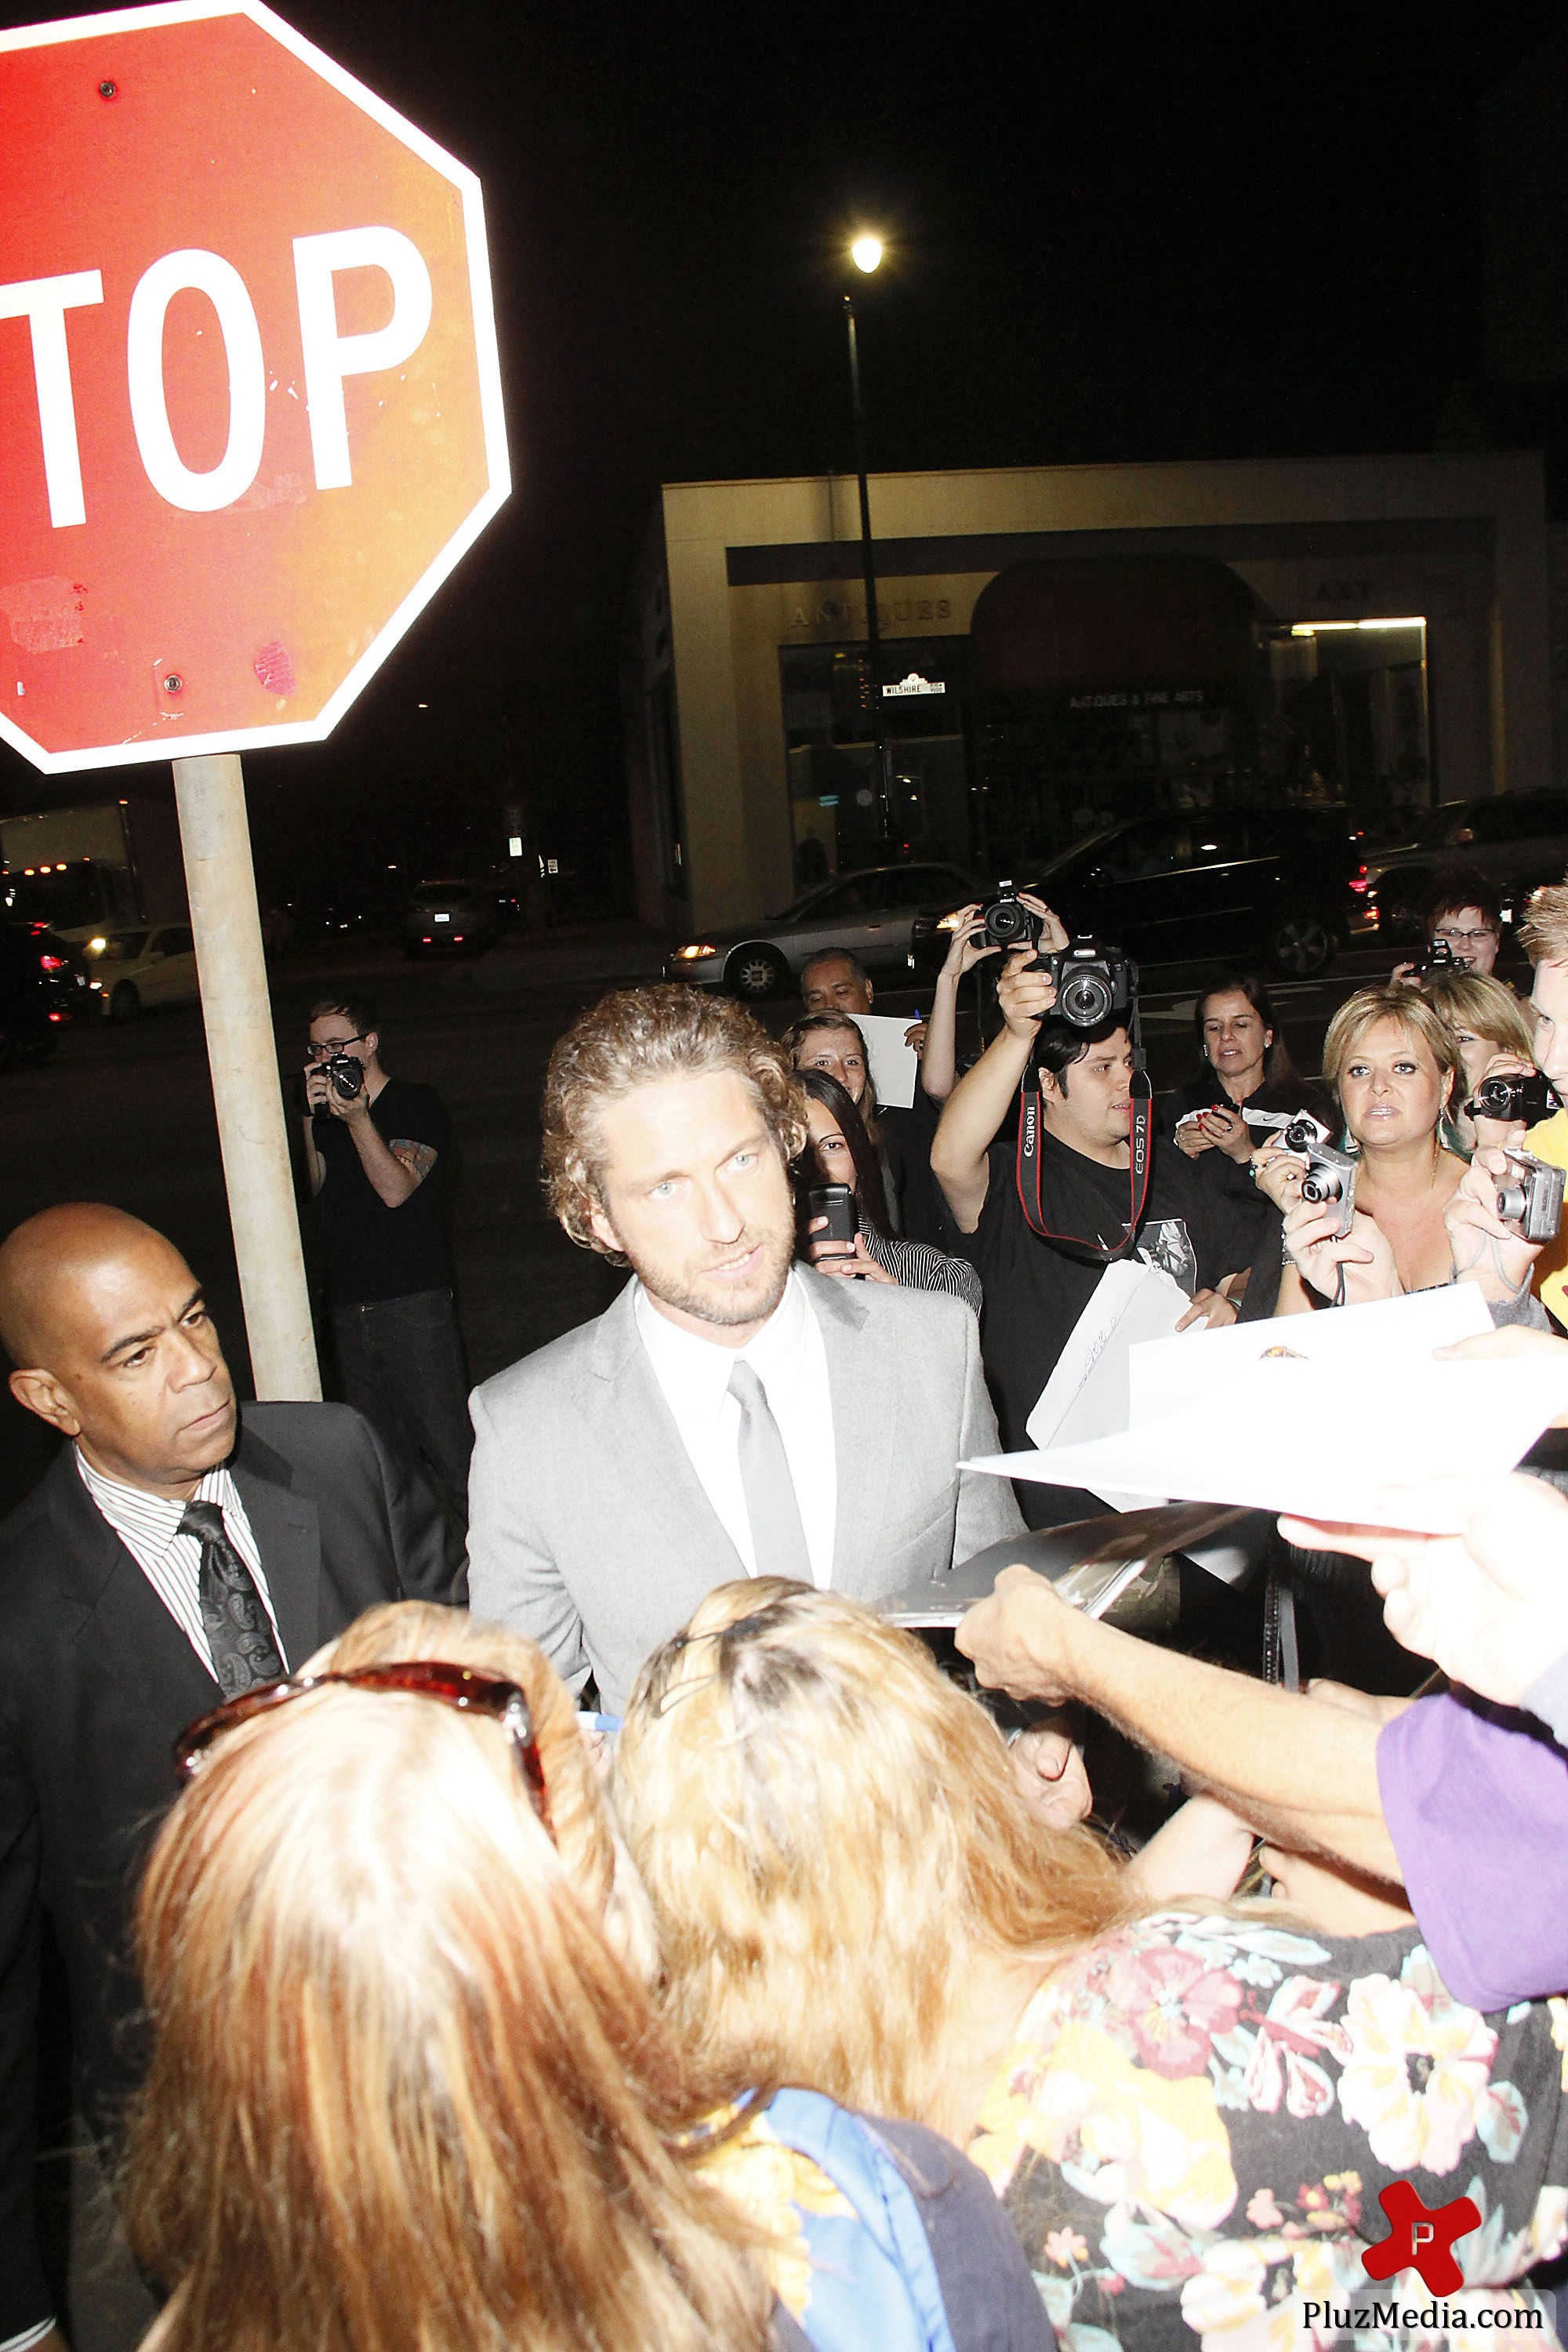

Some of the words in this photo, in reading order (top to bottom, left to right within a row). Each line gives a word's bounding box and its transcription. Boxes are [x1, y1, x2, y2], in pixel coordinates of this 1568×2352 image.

[0, 225, 433, 529] TOP
[886, 685, 921, 695] WILSHIRE
[1024, 1106, 1035, 1157] Canon
[1135, 1115, 1145, 1134] 7D
[1135, 1138, 1145, 1174] EOS
